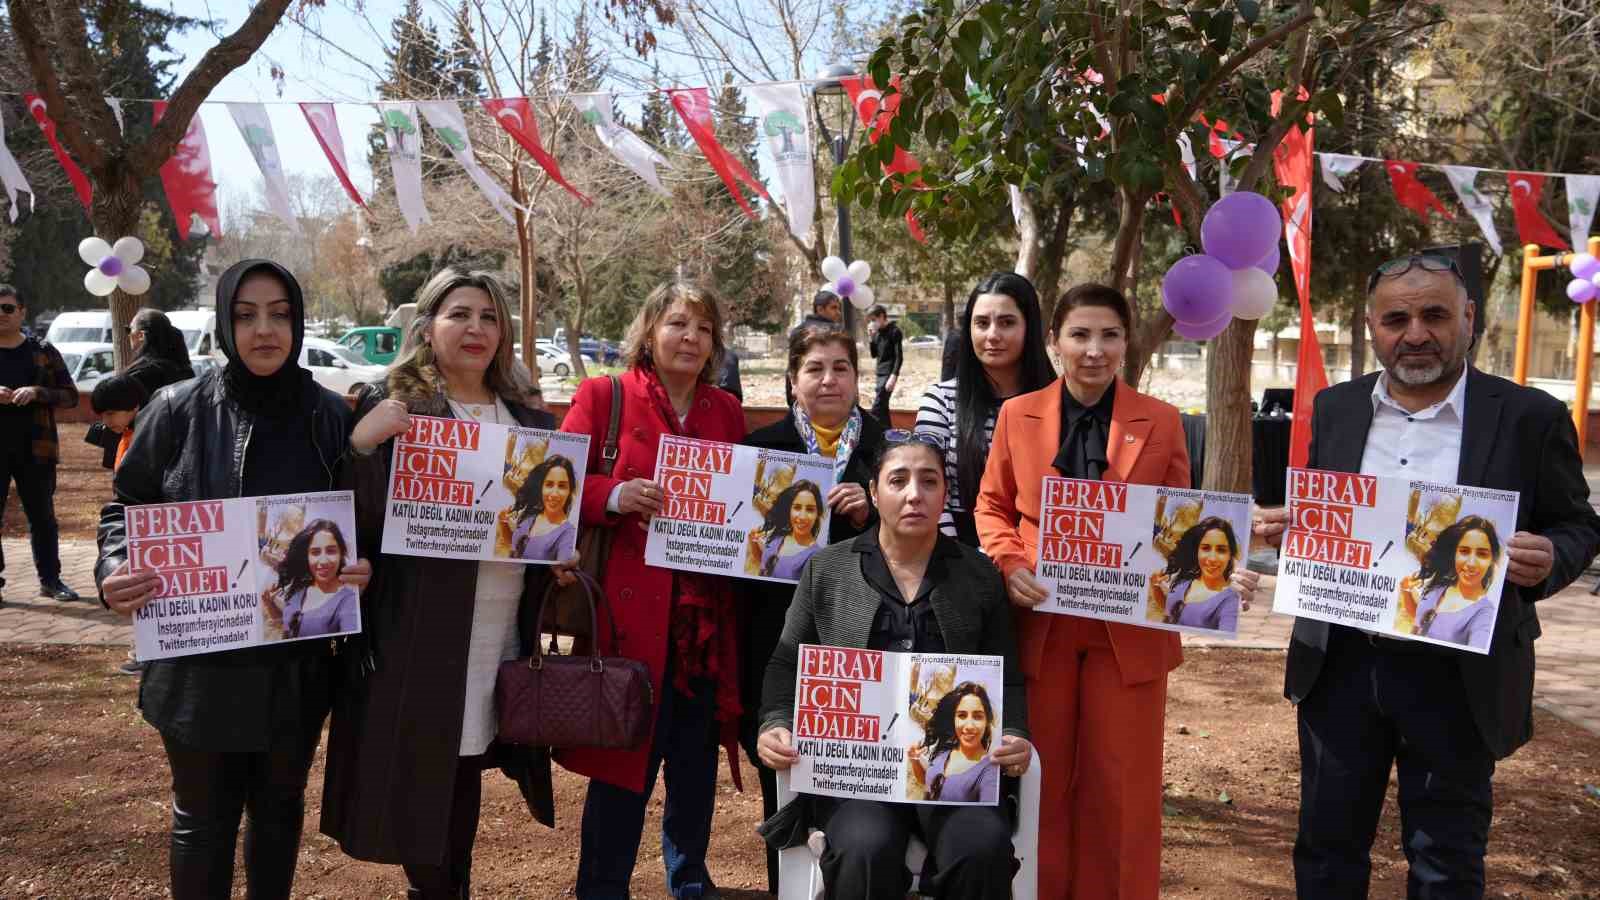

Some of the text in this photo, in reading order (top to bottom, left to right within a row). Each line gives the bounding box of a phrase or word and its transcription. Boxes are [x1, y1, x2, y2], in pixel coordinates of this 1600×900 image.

[397, 445, 456, 479] İÇİN
[663, 442, 731, 473] FERAY
[660, 469, 712, 500] İÇİN
[1046, 480, 1127, 512] FERAY
[1290, 470, 1377, 506] FERAY
[127, 502, 221, 537] FERAY
[420, 502, 443, 521] DEĞİL
[444, 507, 473, 523] KADINI
[473, 510, 496, 525] KORU
[1044, 509, 1103, 543] İÇİN
[1288, 502, 1351, 538] İÇİN
[699, 525, 724, 541] KADINI
[724, 530, 746, 544] KORU
[131, 539, 202, 574] İÇİN
[1068, 563, 1092, 581] DEĞİL
[1093, 569, 1122, 585] KADINI
[1123, 572, 1146, 588] KORU
[1312, 562, 1337, 582] DEĞİL
[1339, 569, 1369, 588] KADINI
[1370, 574, 1396, 592] KORU
[200, 595, 231, 613] KADINI
[233, 592, 258, 608] KORU
[803, 649, 881, 681] FERAY
[800, 678, 860, 715] İÇİN
[825, 740, 849, 758] DEĞİL
[851, 744, 880, 760] KADINI
[881, 746, 904, 762] KORU
